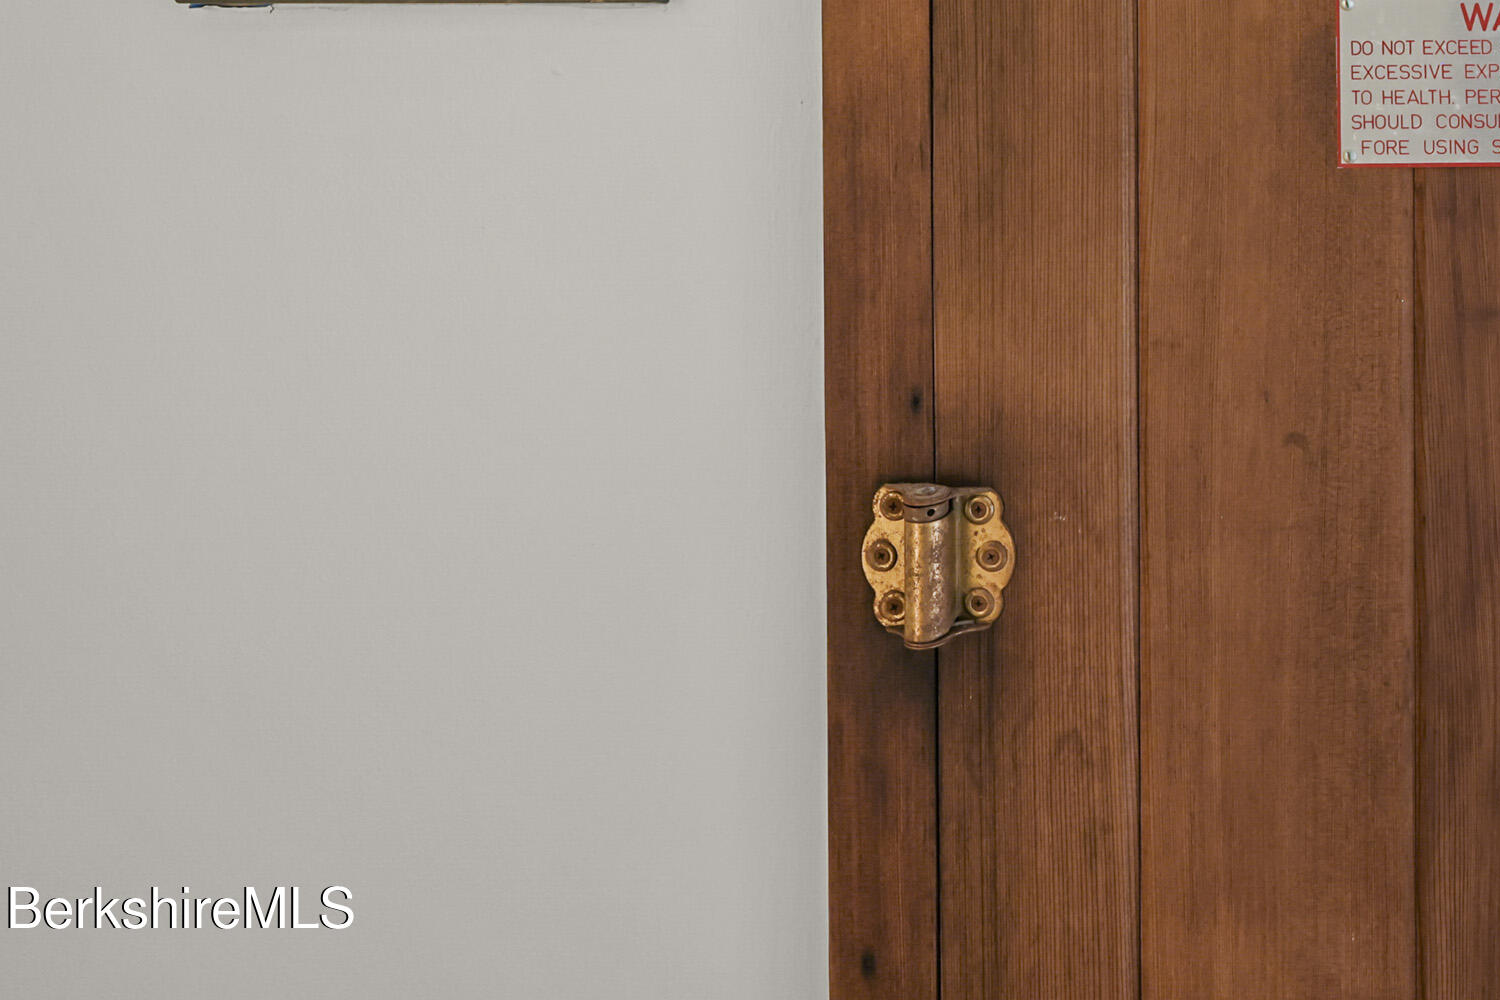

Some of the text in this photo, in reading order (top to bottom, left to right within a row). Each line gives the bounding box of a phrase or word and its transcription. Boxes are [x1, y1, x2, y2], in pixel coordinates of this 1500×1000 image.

[1350, 39, 1375, 57] DO
[1381, 39, 1417, 56] NOT
[1421, 39, 1493, 56] EXCEED
[1350, 63, 1453, 81] EXCESSIVE
[1351, 89, 1374, 106] TO
[1381, 88, 1456, 106] HEALTH.
[1350, 113, 1424, 131] SHOULD
[1360, 139, 1410, 157] FORE
[1422, 138, 1480, 156] USING
